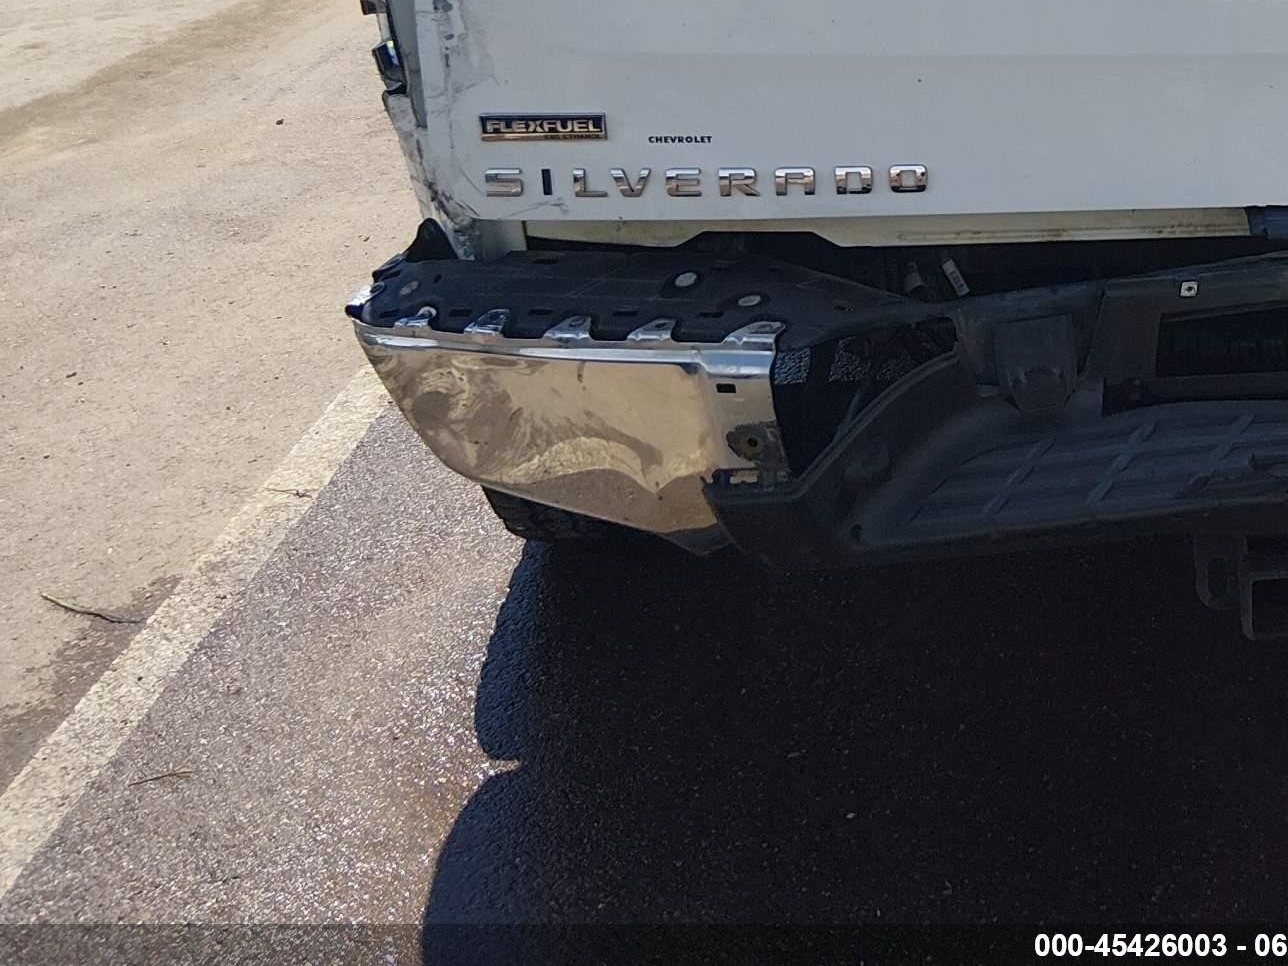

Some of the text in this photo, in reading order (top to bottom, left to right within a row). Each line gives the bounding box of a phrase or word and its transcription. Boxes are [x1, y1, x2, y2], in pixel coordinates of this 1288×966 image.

[486, 119, 601, 133] FLEXFUEL
[648, 136, 713, 144] CHEVROLET
[484, 163, 930, 198] SILVERADO
